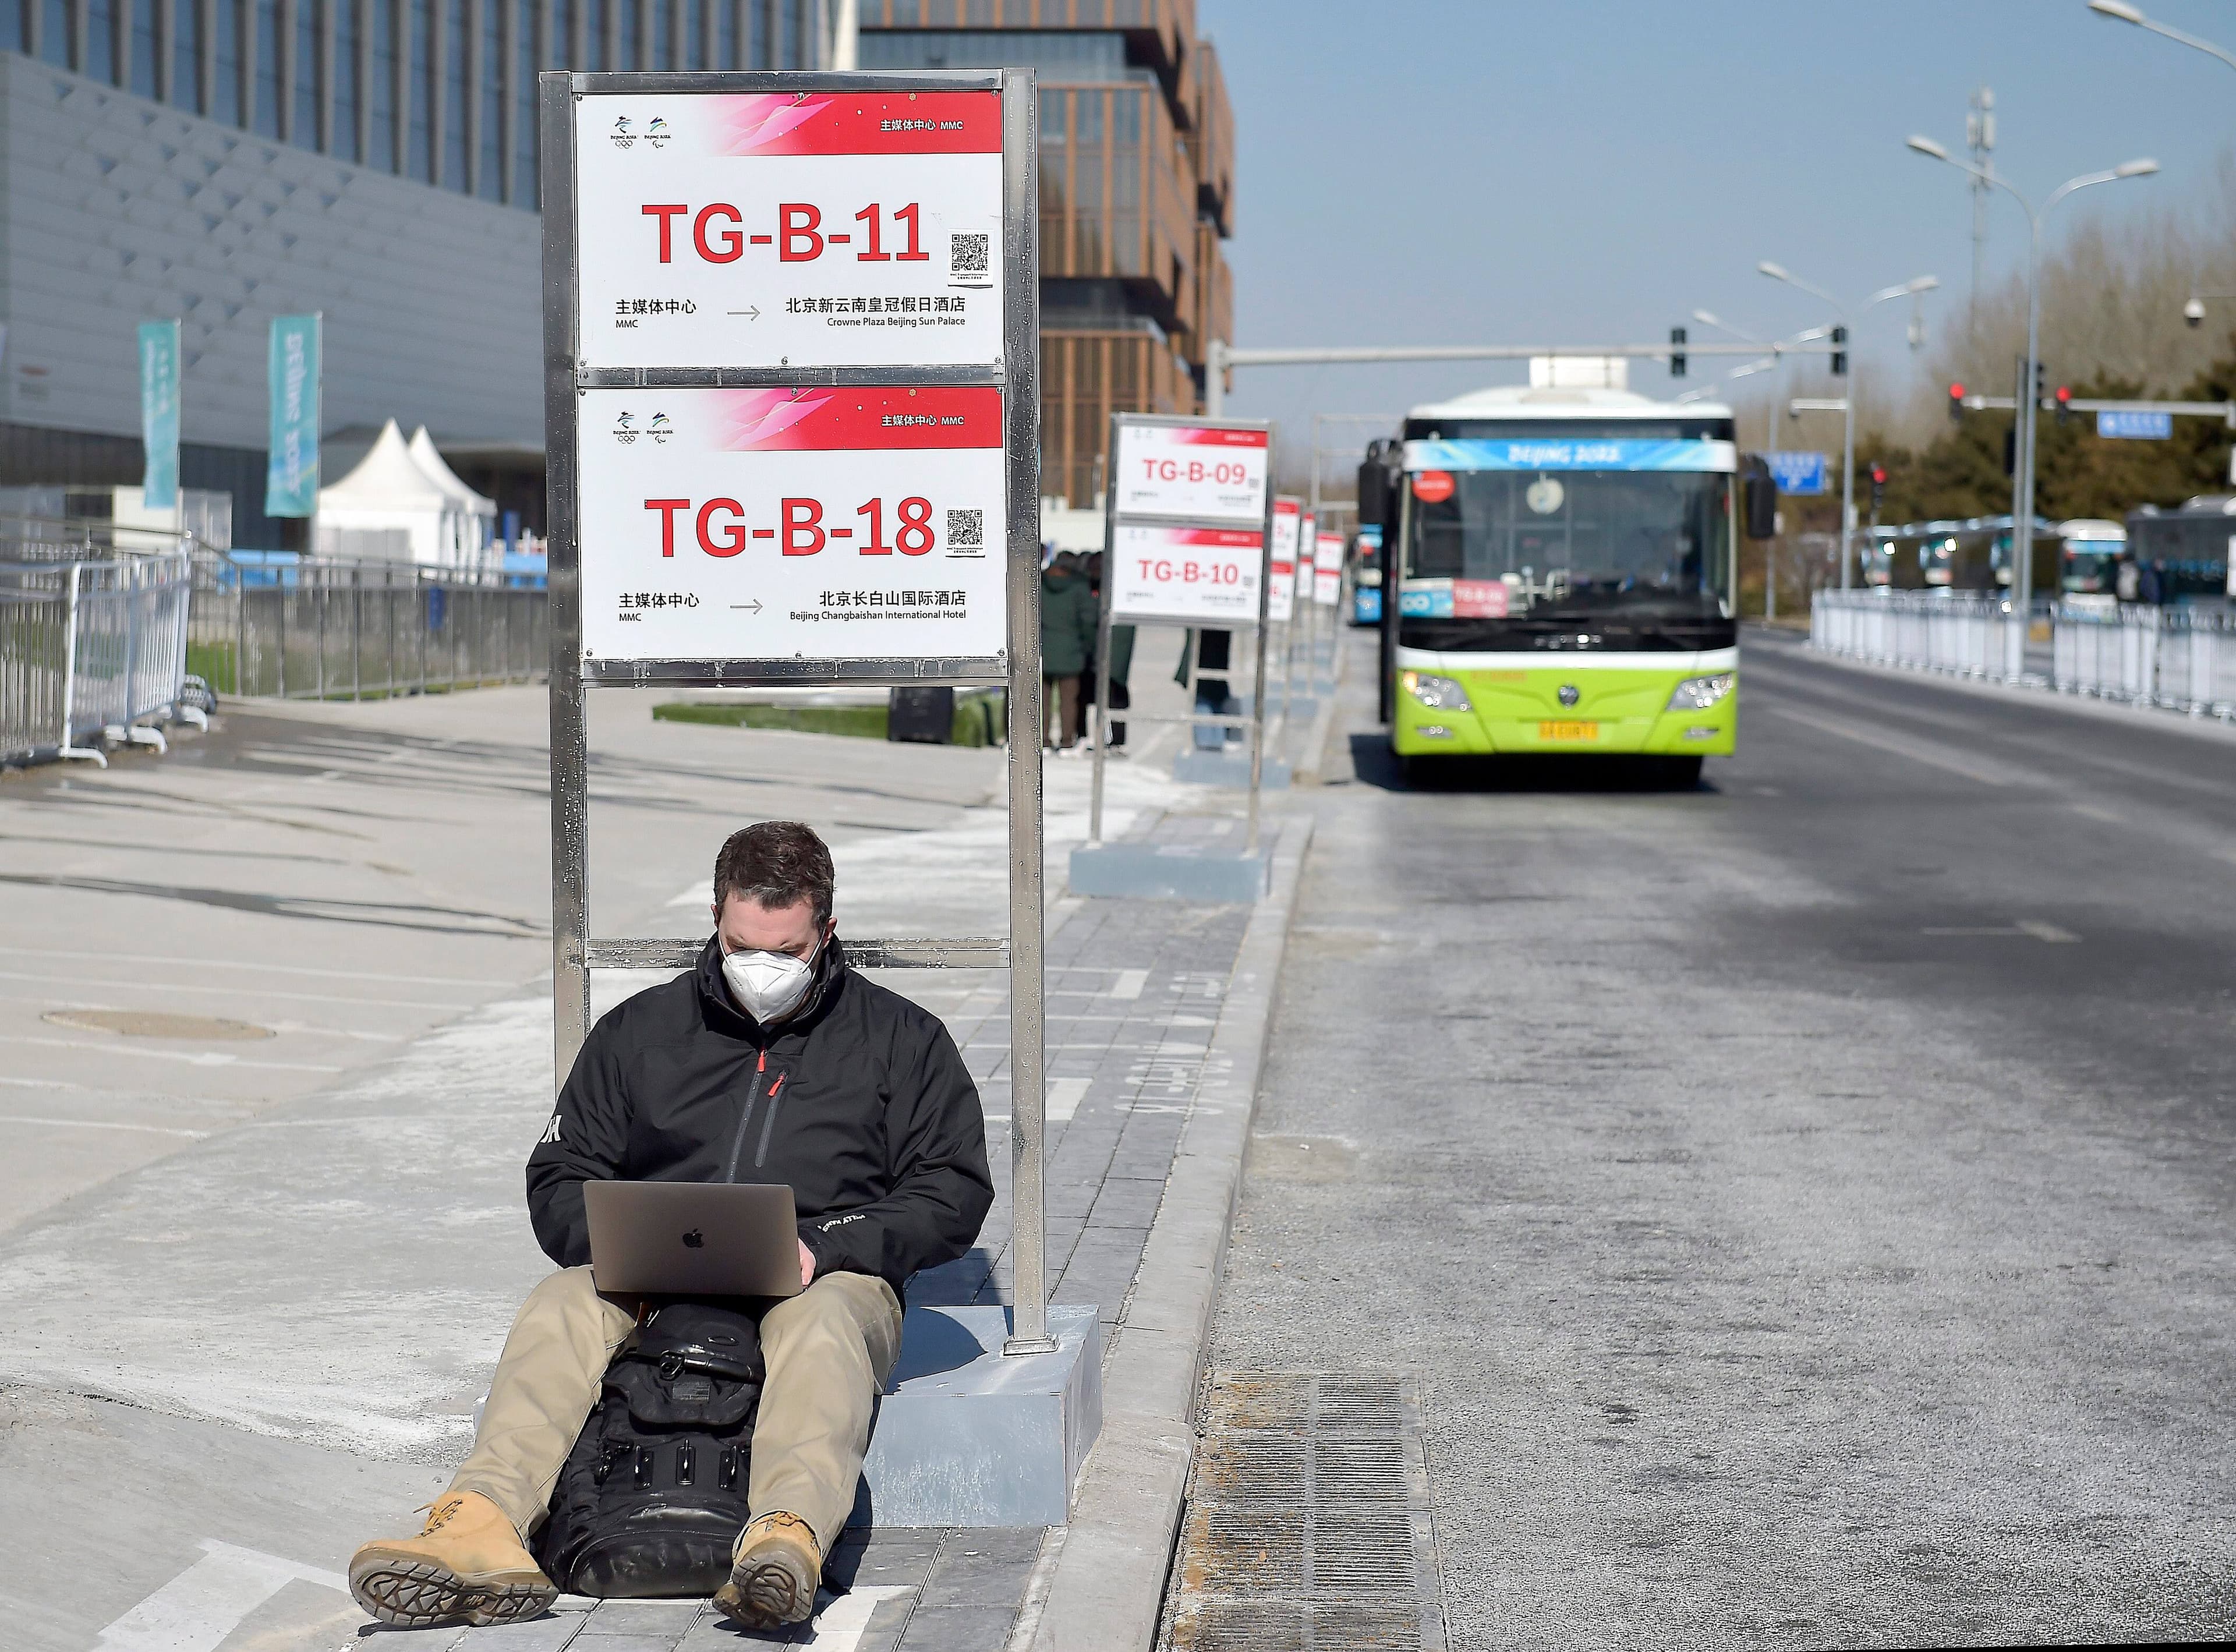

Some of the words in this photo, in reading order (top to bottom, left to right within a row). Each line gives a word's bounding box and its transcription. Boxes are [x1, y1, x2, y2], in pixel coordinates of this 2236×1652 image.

[880, 119, 936, 131] 主媒体中心
[940, 121, 964, 130] MMC
[642, 203, 929, 263] TG-B-11
[615, 298, 696, 315] 主媒体中心
[786, 296, 965, 314] 北京新云南皇冠假日酒店
[615, 319, 639, 328] MMC
[827, 317, 861, 327] Crowne
[863, 317, 886, 326] Plaza
[887, 317, 917, 327] Beijing
[919, 317, 935, 326] Sun
[937, 316, 965, 326] Palace
[882, 414, 937, 426] 主媒体中心
[941, 416, 964, 425] MMC
[1142, 458, 1246, 485] TG-B-09
[645, 497, 935, 557] TG-B-18
[1137, 559, 1240, 585] TG-B-10
[618, 592, 700, 609] 主媒体中心
[819, 589, 966, 607] 北京长白山国际酒店
[619, 613, 642, 622] MMC
[790, 611, 819, 622] Beijing
[821, 610, 883, 621] Changbaishan
[885, 610, 940, 620] International
[943, 609, 966, 619] Hotel
